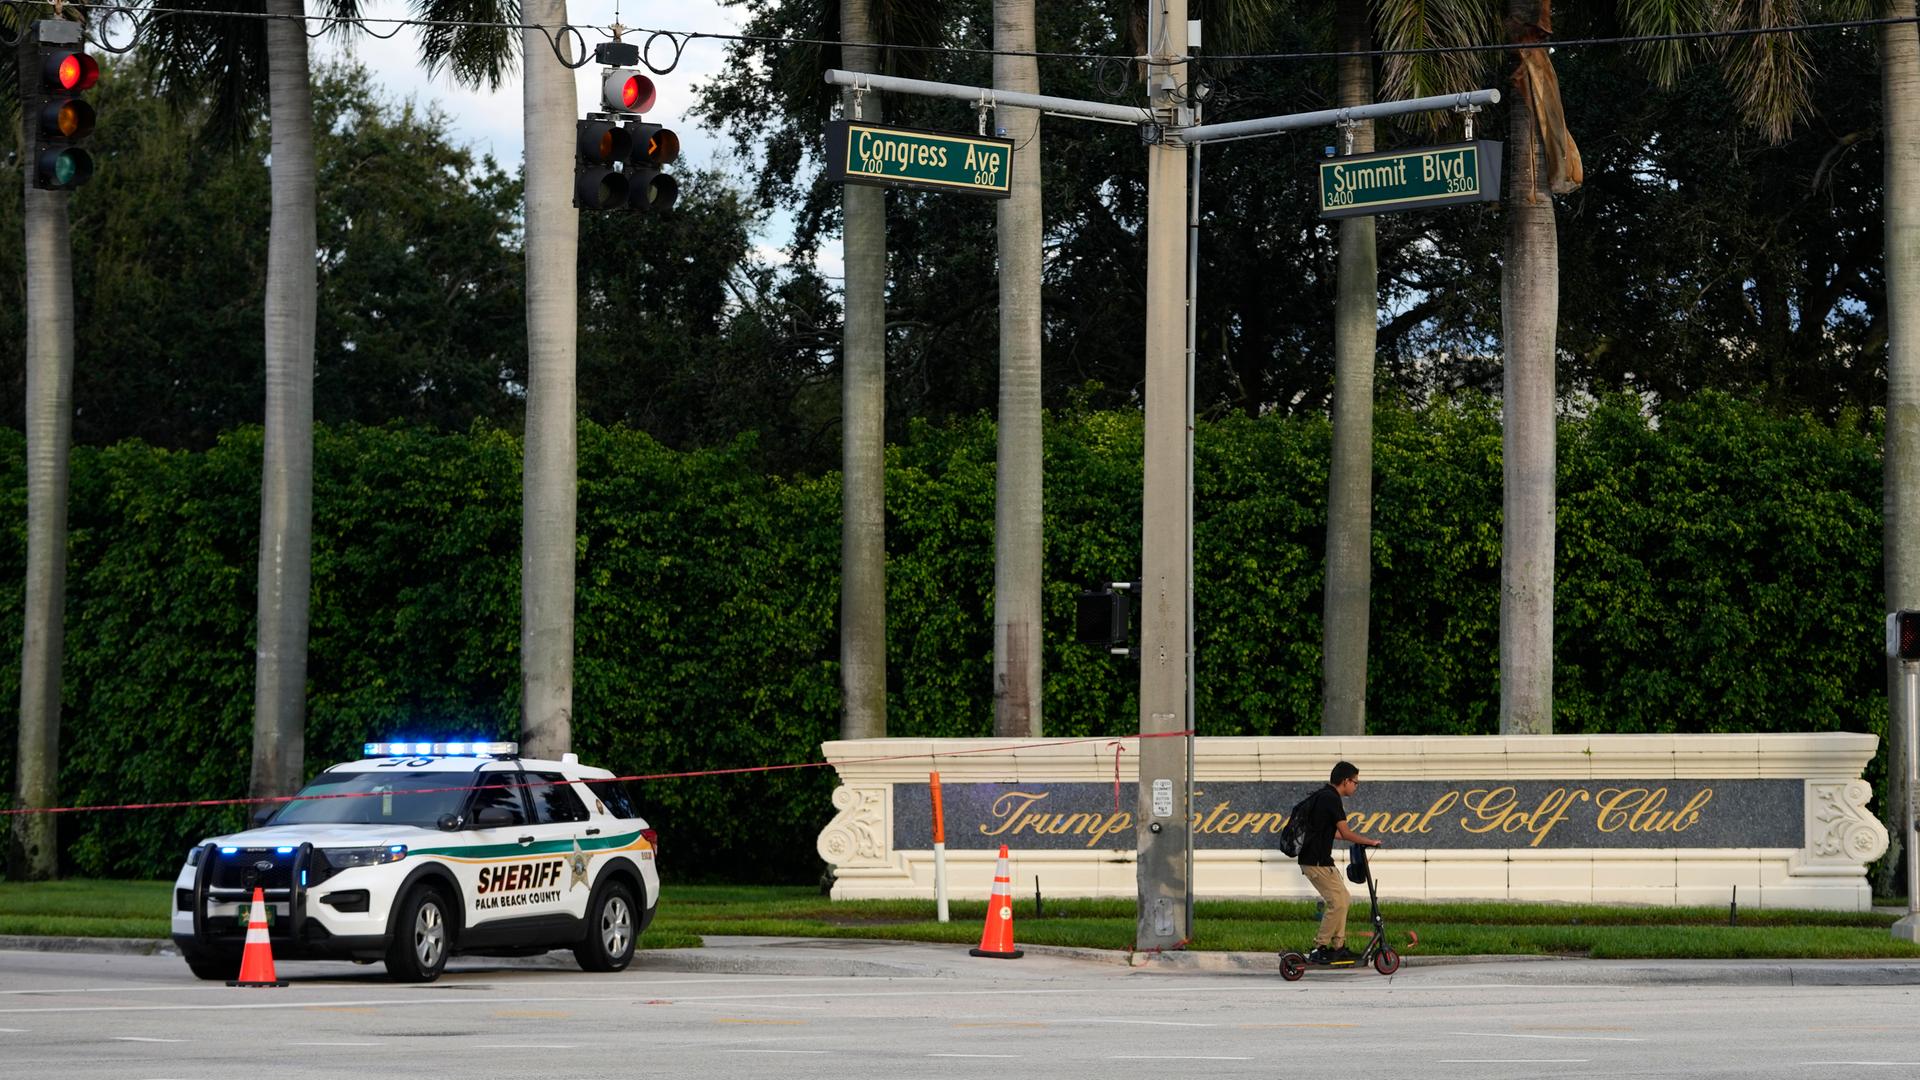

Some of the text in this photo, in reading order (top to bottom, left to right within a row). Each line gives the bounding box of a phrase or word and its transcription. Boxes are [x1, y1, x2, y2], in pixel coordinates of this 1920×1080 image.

[859, 131, 1000, 173] Congress Ave
[862, 158, 883, 174] 700
[1333, 151, 1465, 192] Summit Blvd
[974, 171, 995, 186] 600
[1447, 177, 1474, 193] 3500
[1327, 190, 1354, 206] 3400
[980, 791, 1133, 848] Trump
[1461, 786, 1590, 848] Golf
[1596, 787, 1713, 833] Club
[477, 860, 563, 894] SHERIFF
[475, 890, 561, 910] PALM BEACH COUNTY
